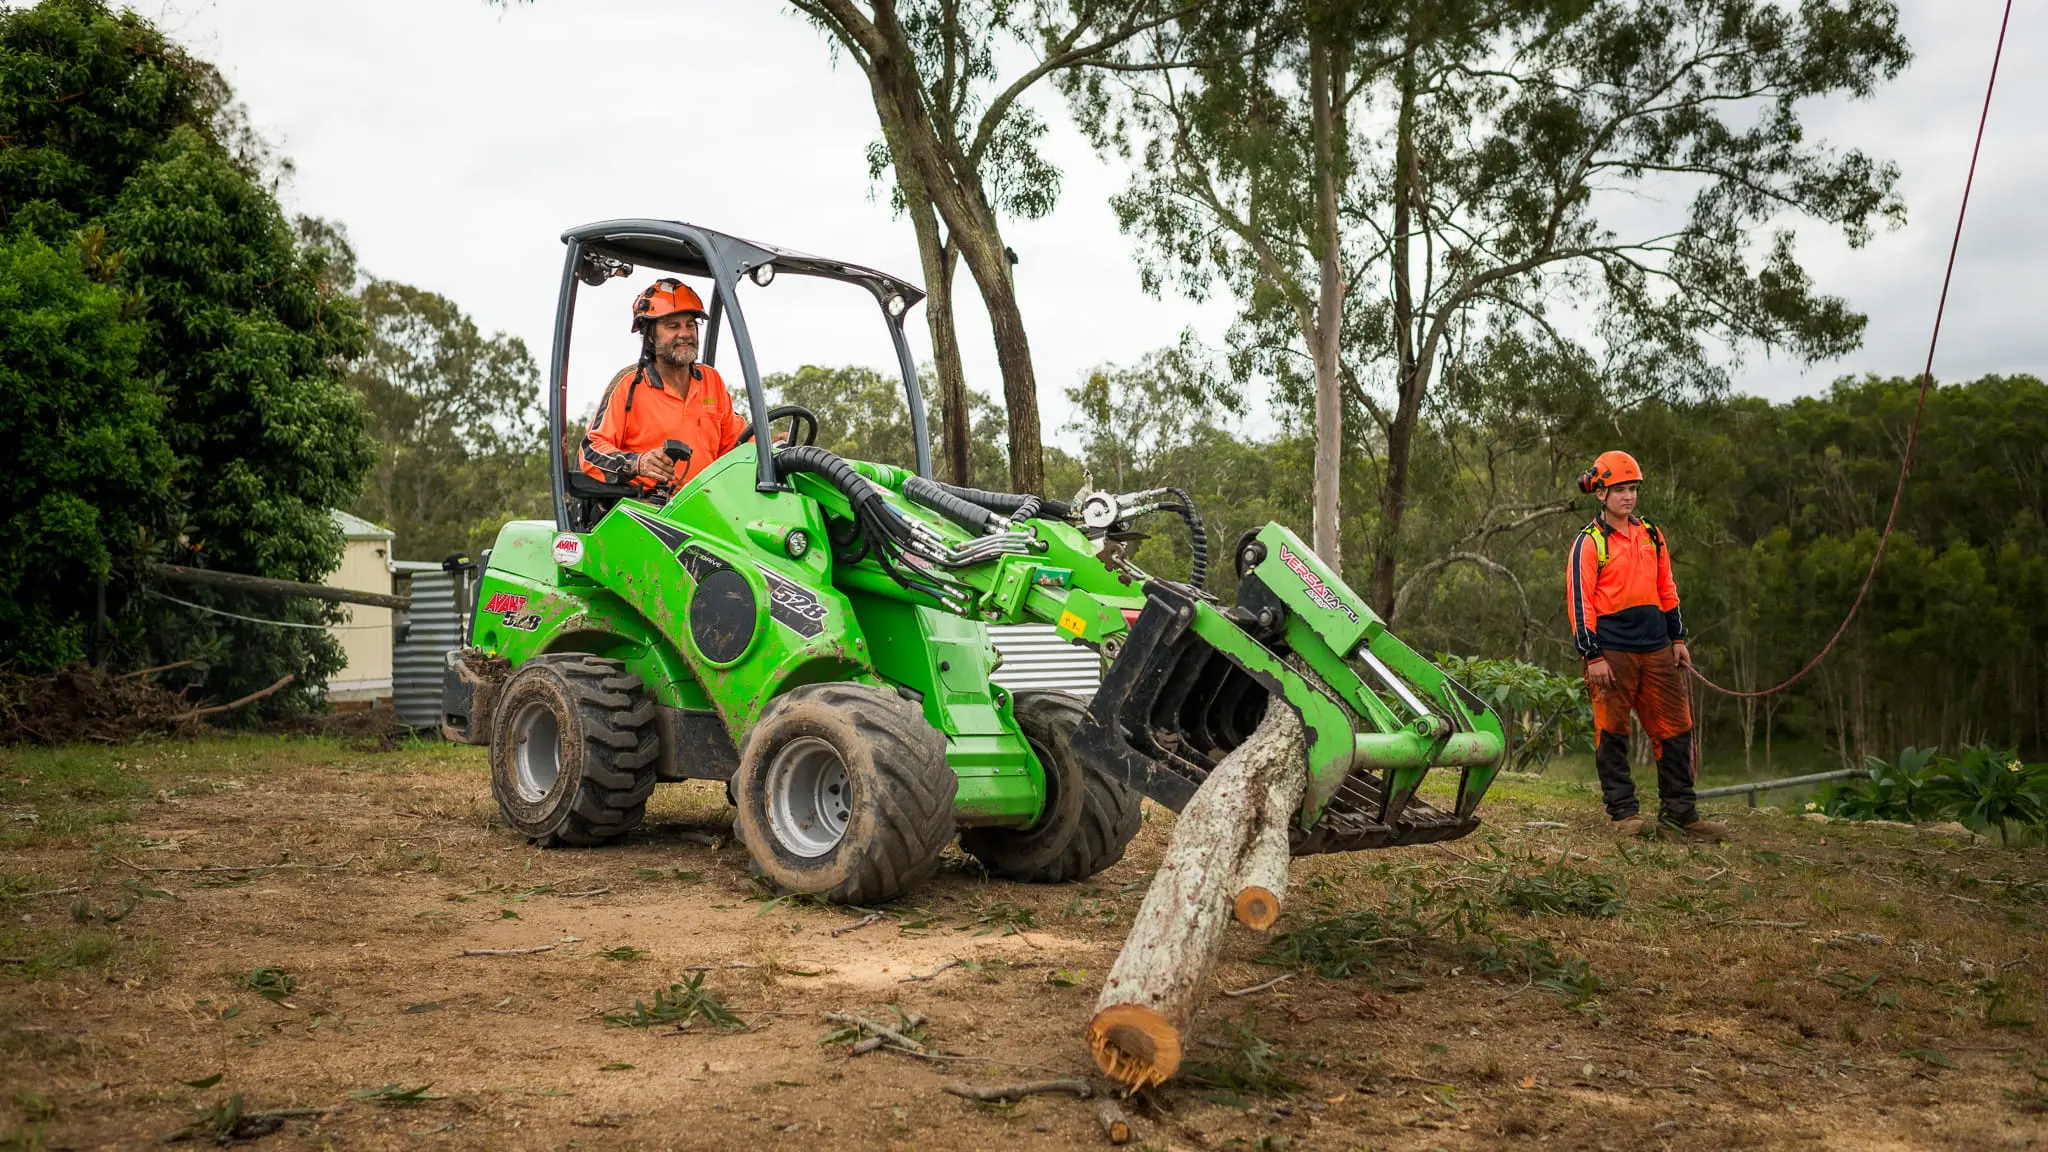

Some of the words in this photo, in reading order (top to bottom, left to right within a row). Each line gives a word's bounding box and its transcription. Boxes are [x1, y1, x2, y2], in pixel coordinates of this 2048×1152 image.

[555, 540, 578, 552] AVANT
[482, 591, 528, 614] AVANT
[771, 585, 829, 620] 528
